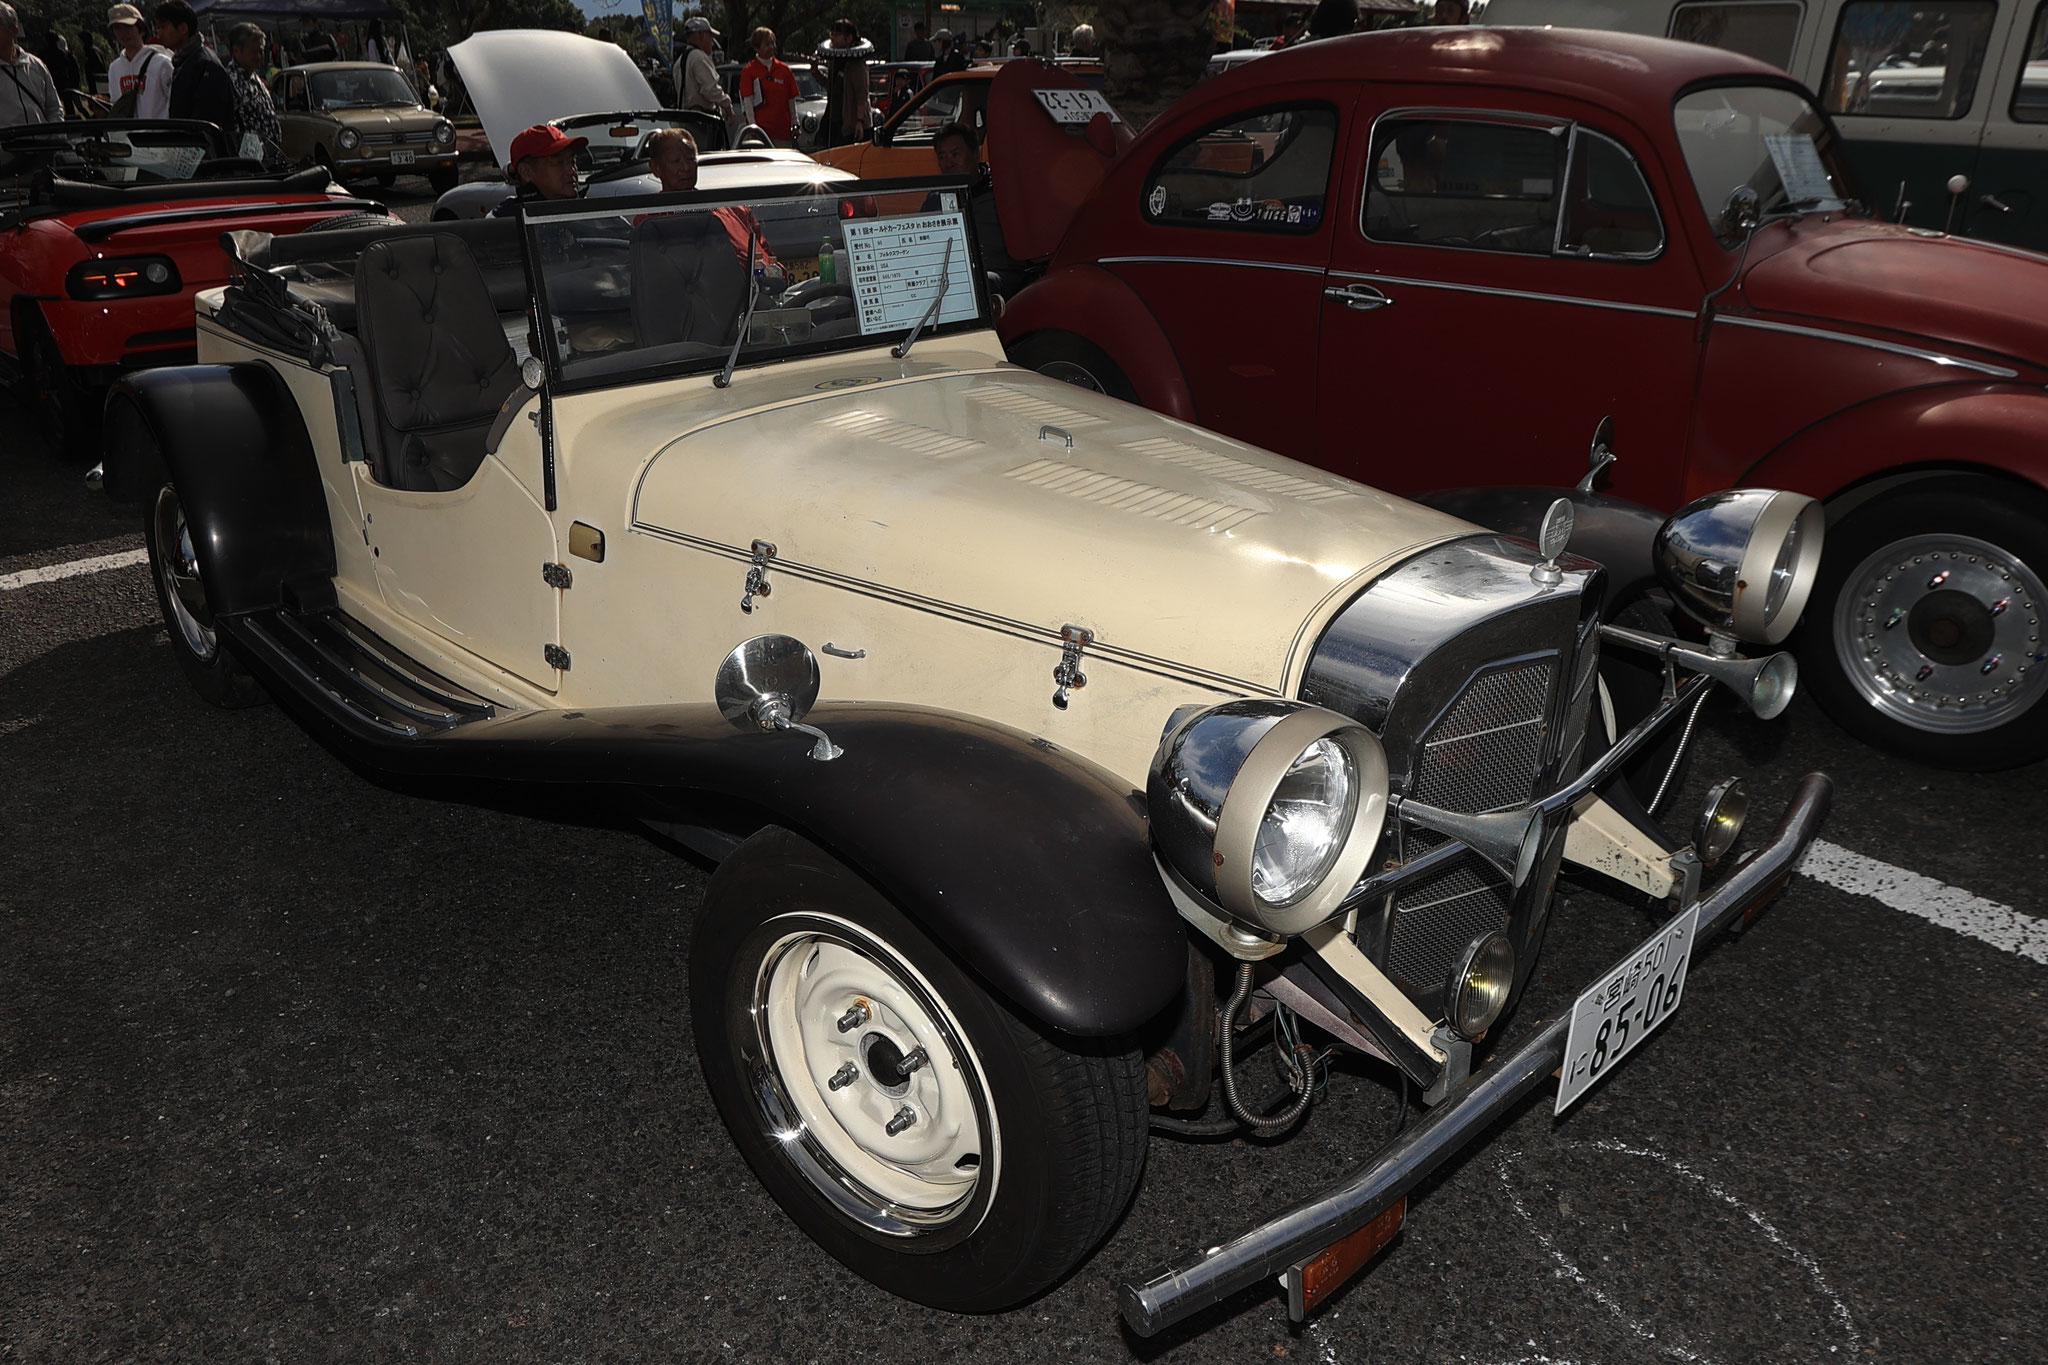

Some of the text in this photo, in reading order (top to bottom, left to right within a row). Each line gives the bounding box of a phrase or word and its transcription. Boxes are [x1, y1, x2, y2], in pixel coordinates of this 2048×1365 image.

[1568, 954, 1685, 1085] に 85-06
[1602, 933, 1673, 1014] 宮崎501
